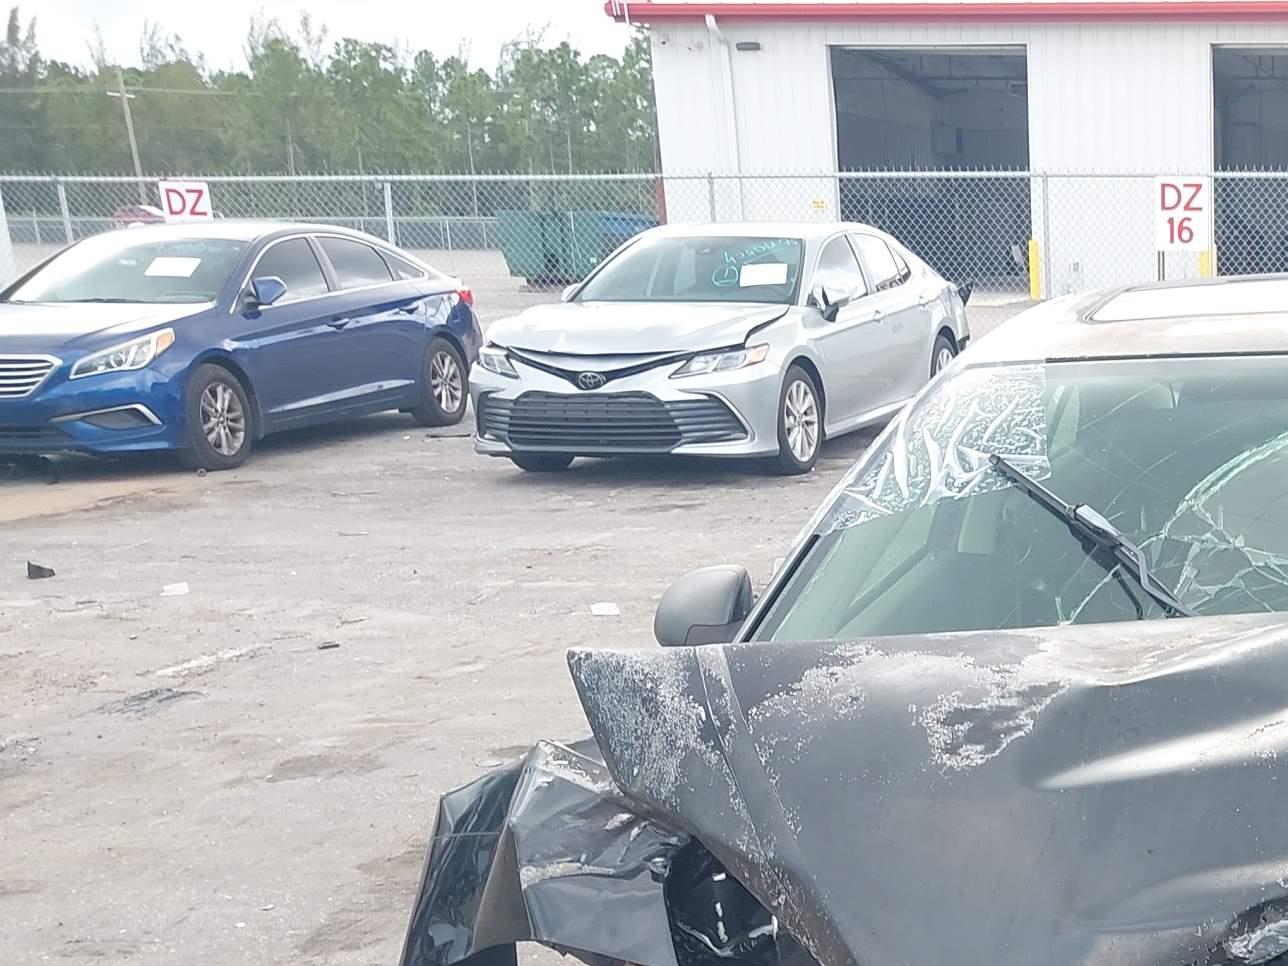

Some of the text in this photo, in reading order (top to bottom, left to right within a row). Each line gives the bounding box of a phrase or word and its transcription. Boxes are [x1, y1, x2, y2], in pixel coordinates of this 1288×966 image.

[165, 188, 208, 216] DZ
[1160, 183, 1203, 211] DZ
[1167, 216, 1194, 244] 16
